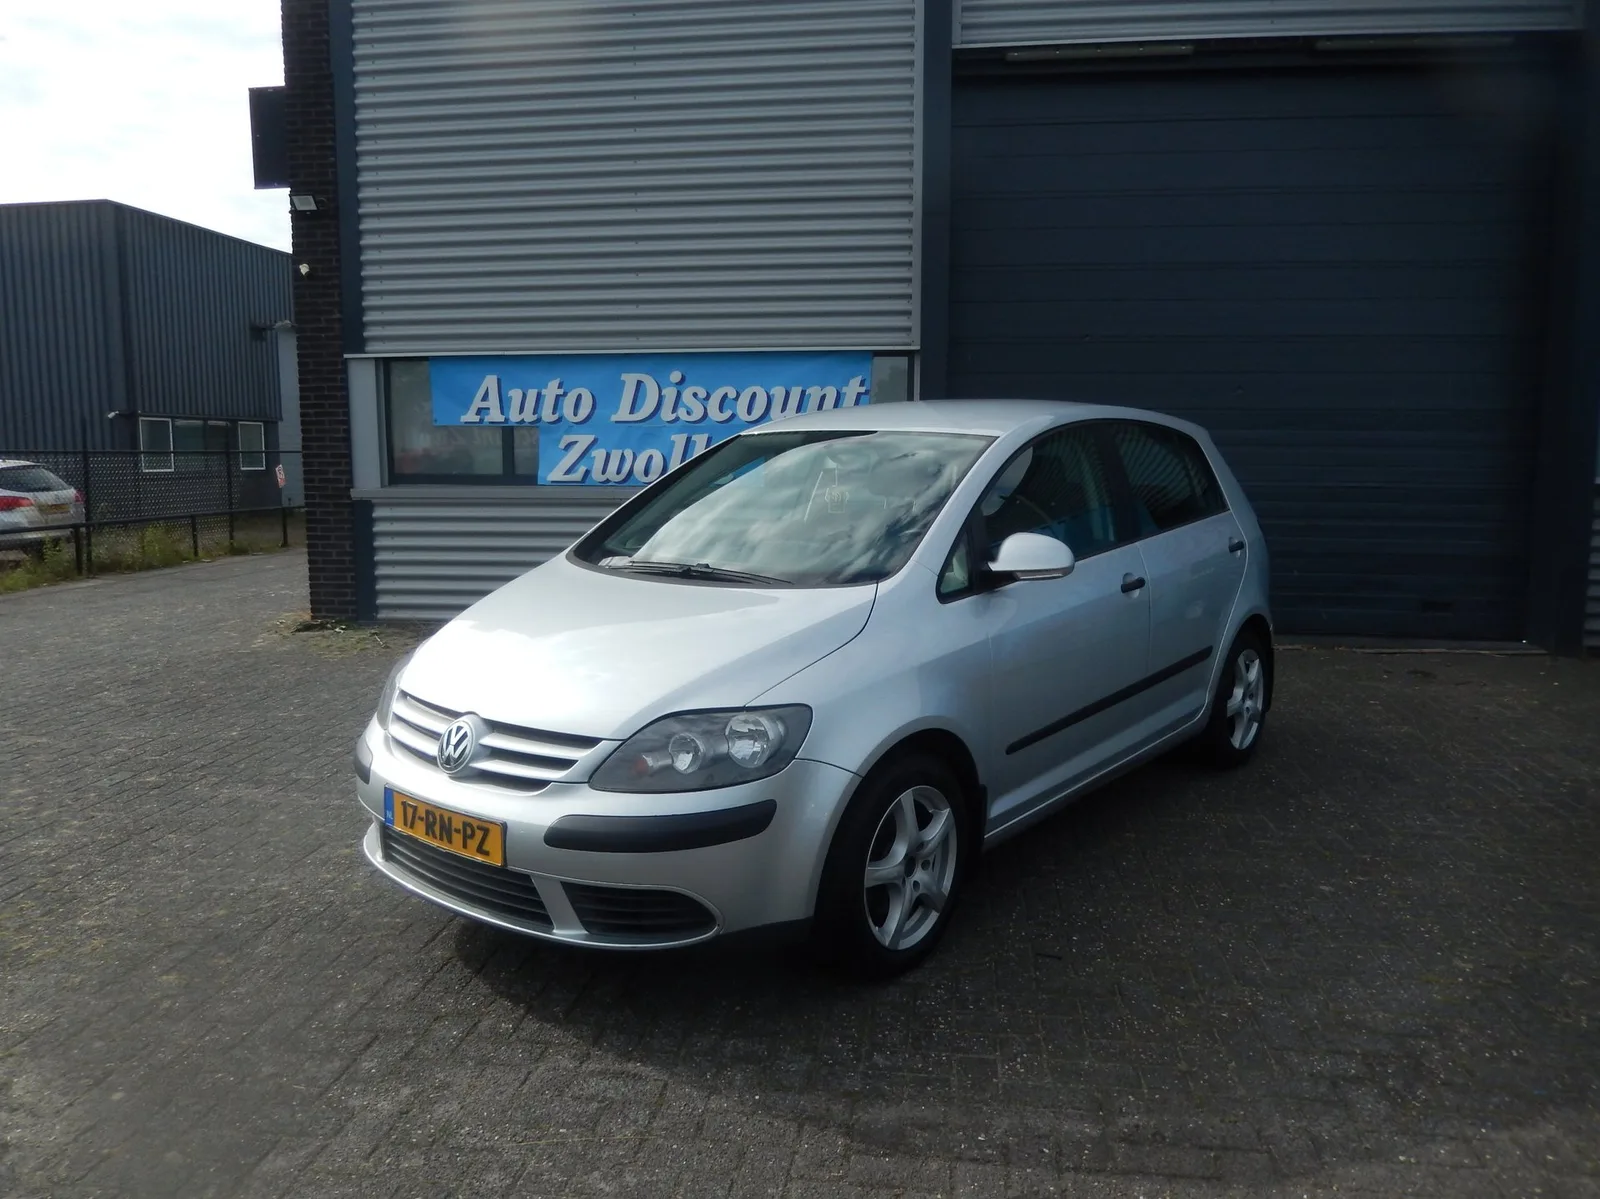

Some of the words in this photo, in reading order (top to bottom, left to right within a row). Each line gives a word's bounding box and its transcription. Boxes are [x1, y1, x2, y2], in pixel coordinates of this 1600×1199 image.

[460, 374, 597, 425] Auto
[610, 370, 869, 425] Discount
[401, 800, 490, 856] 17-RN-PZ
